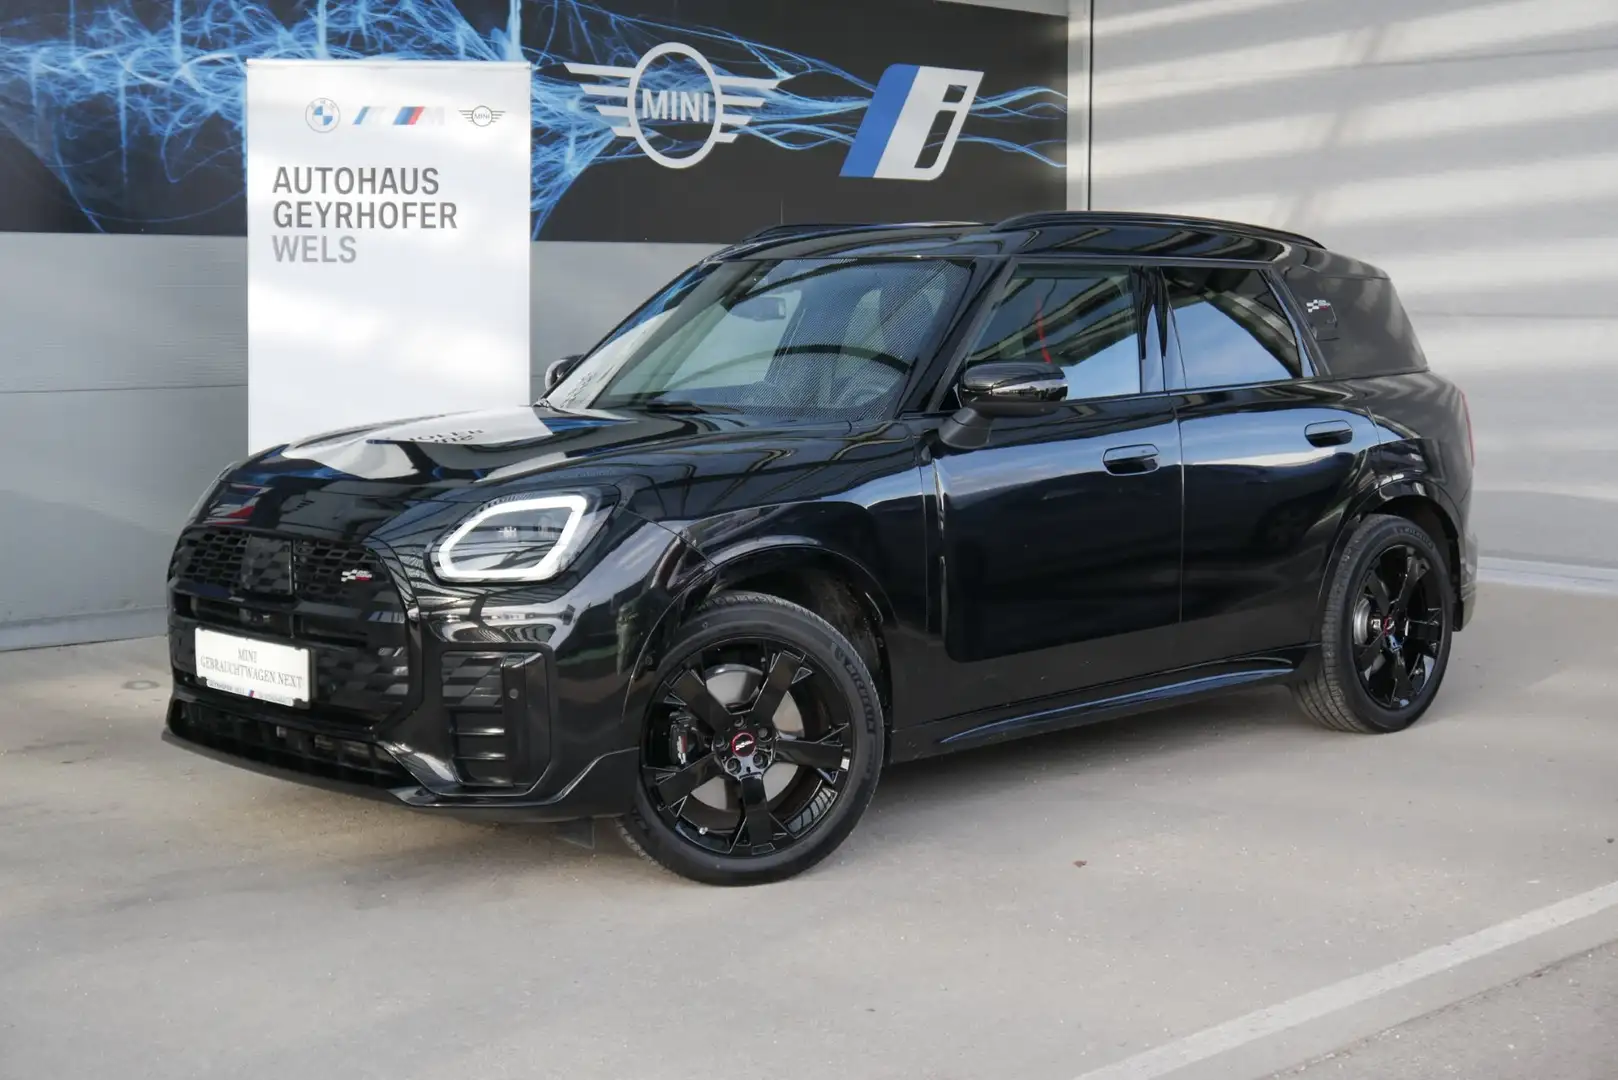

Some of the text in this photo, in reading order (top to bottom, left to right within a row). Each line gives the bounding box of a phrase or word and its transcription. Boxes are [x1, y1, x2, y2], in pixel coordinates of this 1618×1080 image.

[474, 112, 491, 120] MINI
[642, 89, 710, 123] MINI
[272, 166, 439, 195] AUTOHAUS
[273, 200, 457, 230] GEYRHOFER
[272, 234, 357, 264] WELS
[238, 648, 257, 664] MINI
[200, 655, 303, 689] GEBRAUCHTWAGEN NEXT
